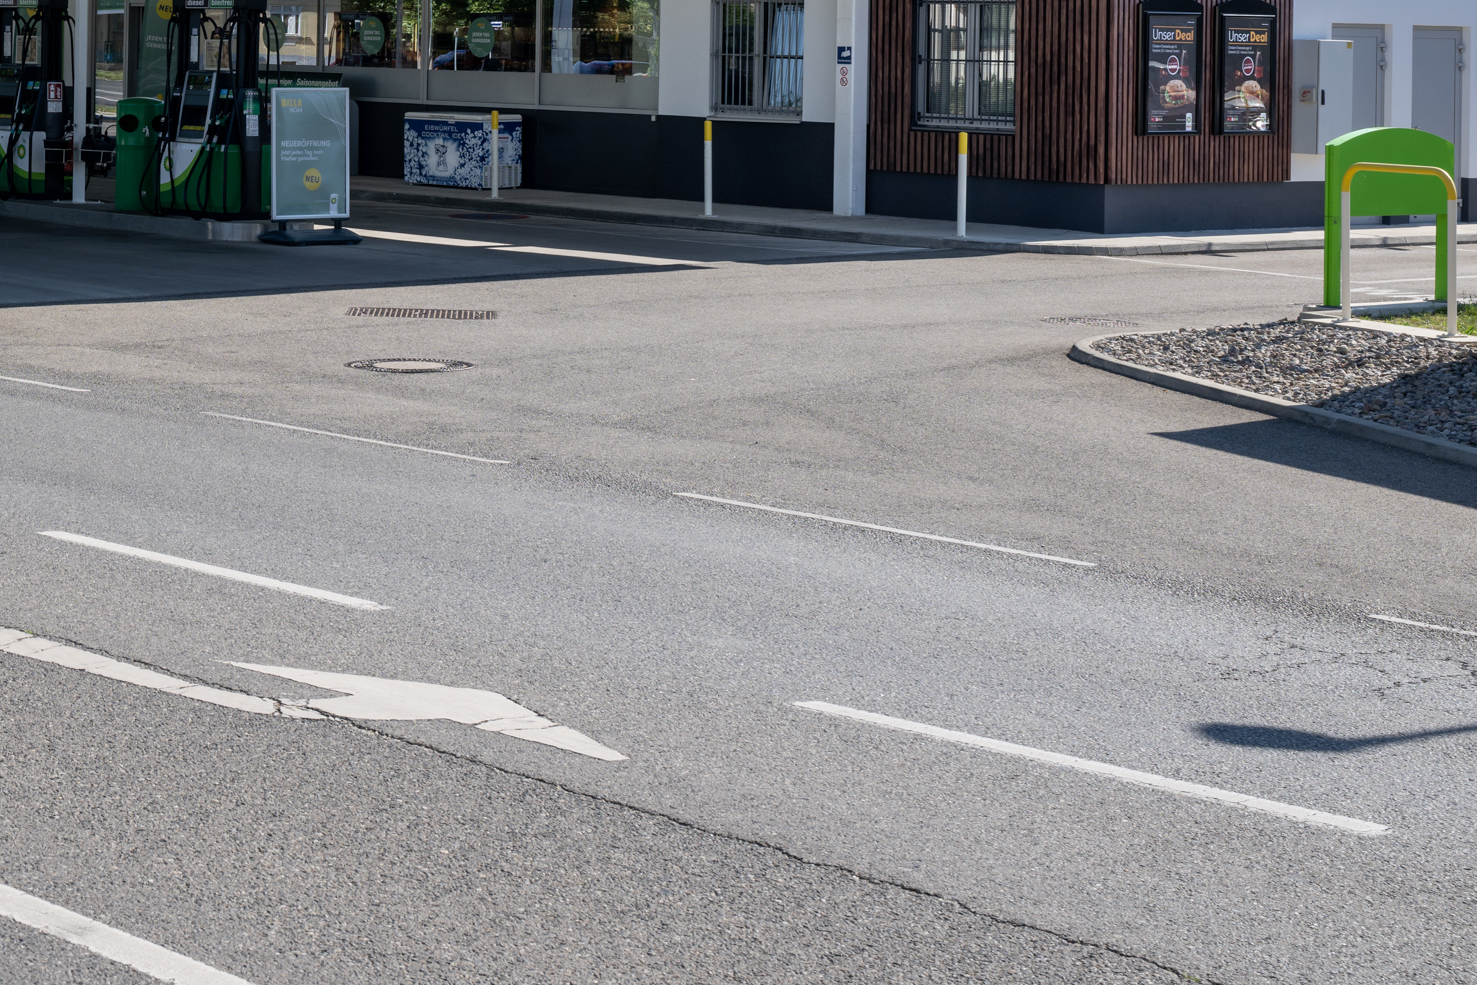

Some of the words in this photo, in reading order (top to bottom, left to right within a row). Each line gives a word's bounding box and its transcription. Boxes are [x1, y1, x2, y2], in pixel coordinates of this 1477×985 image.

[145, 34, 163, 42] JEDEN
[1152, 28, 1175, 41] Unser
[1175, 29, 1194, 41] Deal
[1228, 30, 1250, 42] Unser
[1250, 31, 1268, 43] Deal
[296, 77, 339, 88] Saisonangebot
[280, 98, 303, 108] BILLA
[424, 123, 459, 132] EISWÜRFEL
[421, 131, 450, 139] COCKTAIL
[280, 138, 331, 148] NEUERÖFFNUNG
[305, 175, 320, 184] NEU
